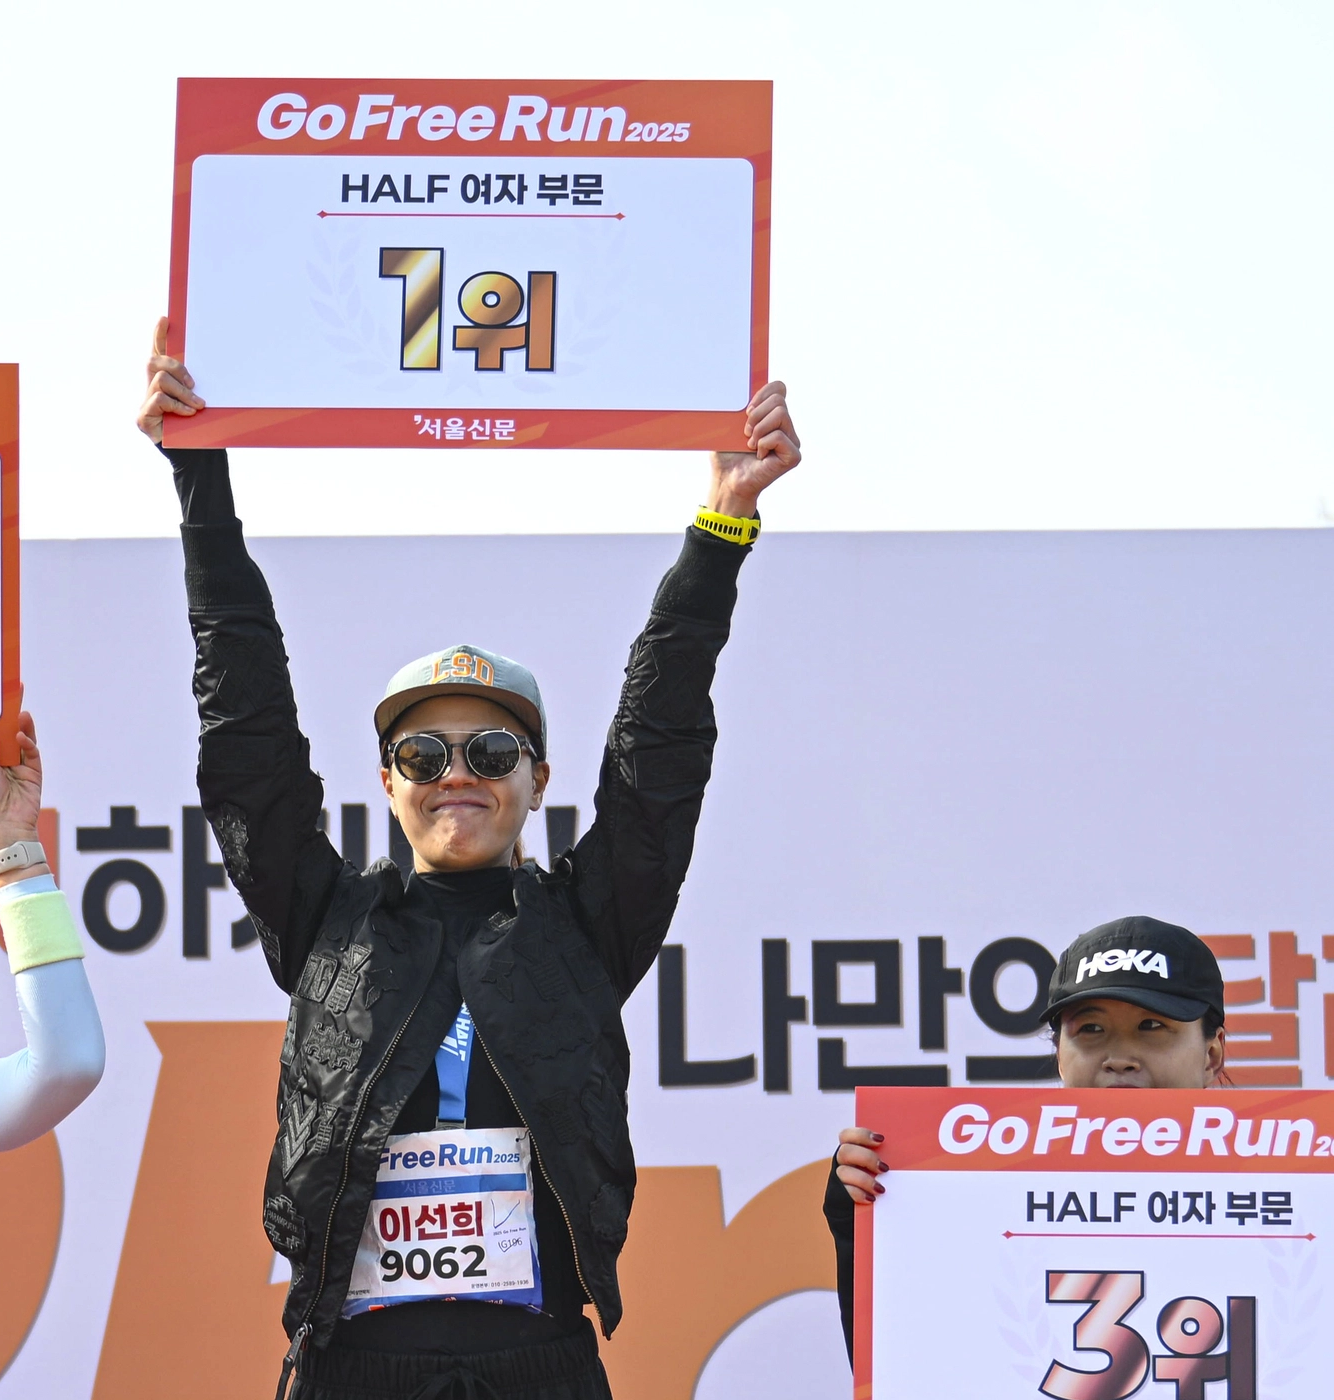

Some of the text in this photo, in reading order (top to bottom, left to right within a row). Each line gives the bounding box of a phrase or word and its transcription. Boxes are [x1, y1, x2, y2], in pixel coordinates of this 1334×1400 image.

[626, 122, 690, 143] 2025
[342, 173, 603, 206] HALF 여자 부문
[379, 247, 556, 372] 1위
[429, 653, 494, 686] LSD
[1075, 949, 1169, 984] HOKA
[493, 1154, 520, 1164] 2025
[379, 1200, 484, 1242] 이선희
[1027, 1191, 1293, 1226] HALF 여자 부문
[380, 1245, 487, 1282] 9062
